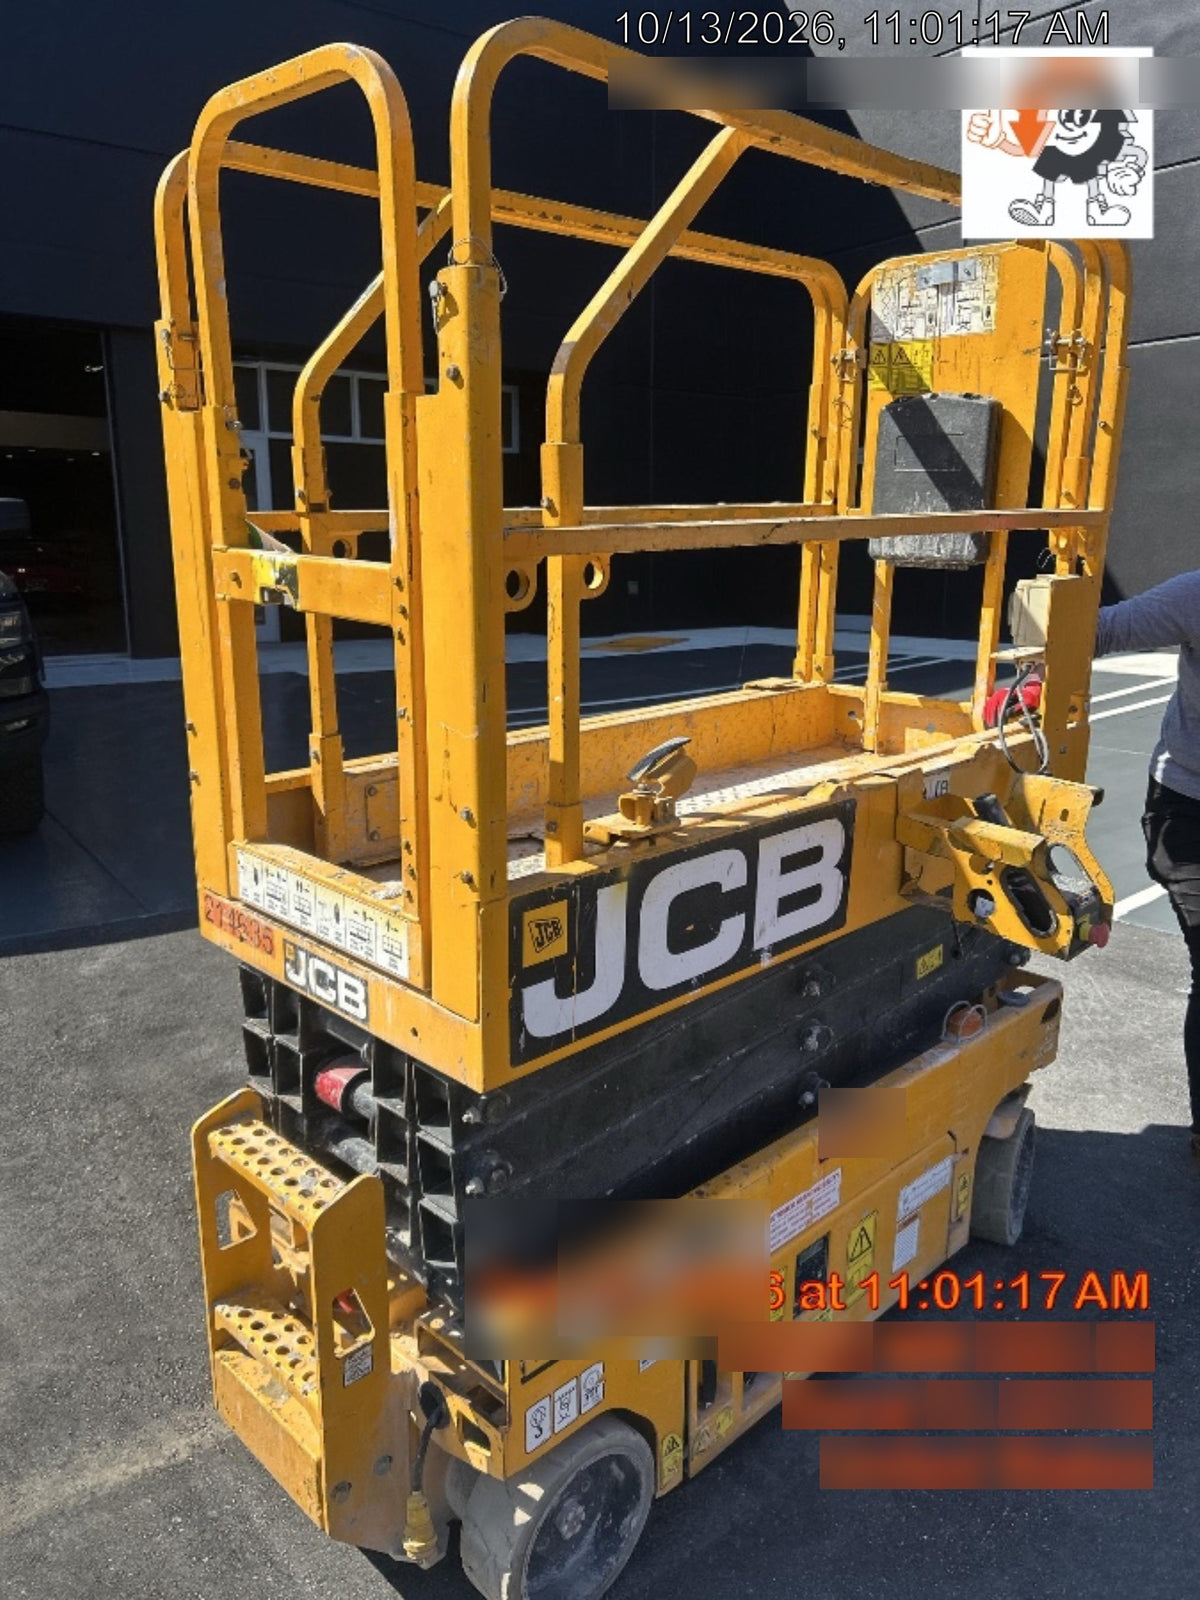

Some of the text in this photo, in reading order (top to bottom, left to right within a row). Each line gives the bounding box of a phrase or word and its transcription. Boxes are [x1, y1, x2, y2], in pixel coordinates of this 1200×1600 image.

[522, 818, 846, 1039] JCB
[533, 918, 563, 949] JCB
[285, 949, 367, 1020] JCB
